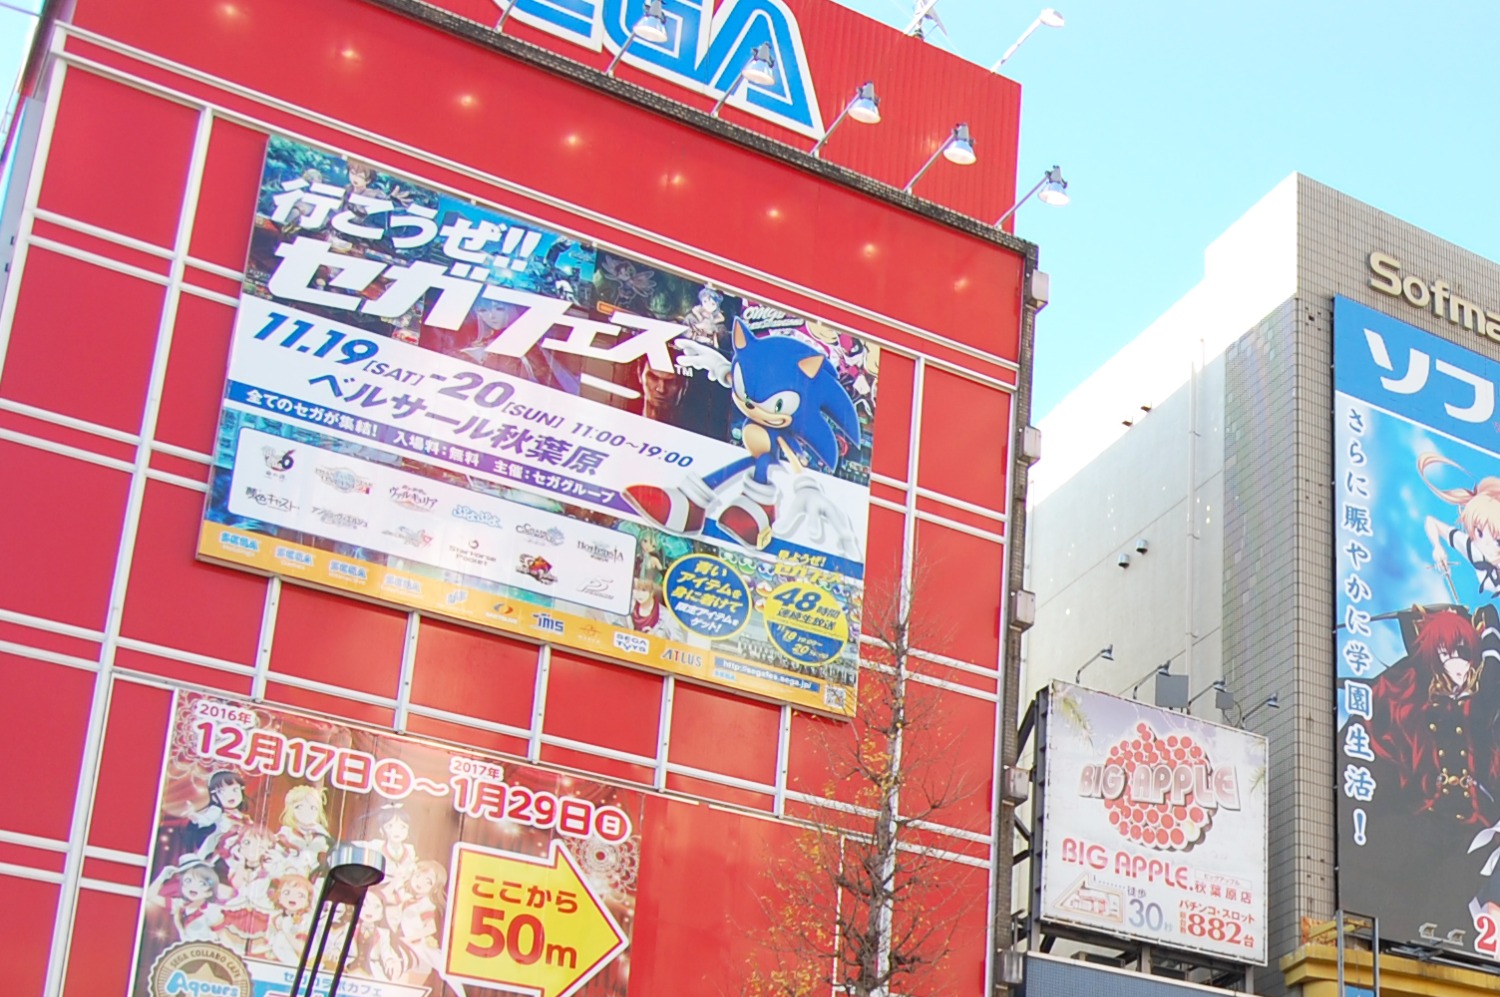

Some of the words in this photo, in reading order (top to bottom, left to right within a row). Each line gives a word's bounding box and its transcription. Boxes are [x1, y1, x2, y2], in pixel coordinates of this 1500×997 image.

[494, 0, 826, 141] GA
[271, 178, 540, 272] 行こうぜ!!
[266, 236, 686, 375] セガフェス
[246, 388, 379, 438] 全てのセガが集結!
[393, 430, 480, 468] 入場料:無料
[493, 459, 616, 504] 主催:セガグループ
[307, 369, 612, 480] ベルサール秋葉原
[1342, 407, 1378, 847] さらに賑やかに学園生活!
[661, 648, 702, 667] ATLUS
[199, 703, 253, 726] 2016年
[452, 758, 504, 781] 2017年
[1079, 763, 1127, 800] BIG
[1131, 763, 1241, 811] APPLE
[1061, 837, 1109, 870] BIG
[470, 874, 579, 915] ここから
[1194, 880, 1253, 905] 秋葉原店
[464, 909, 578, 970] 50m
